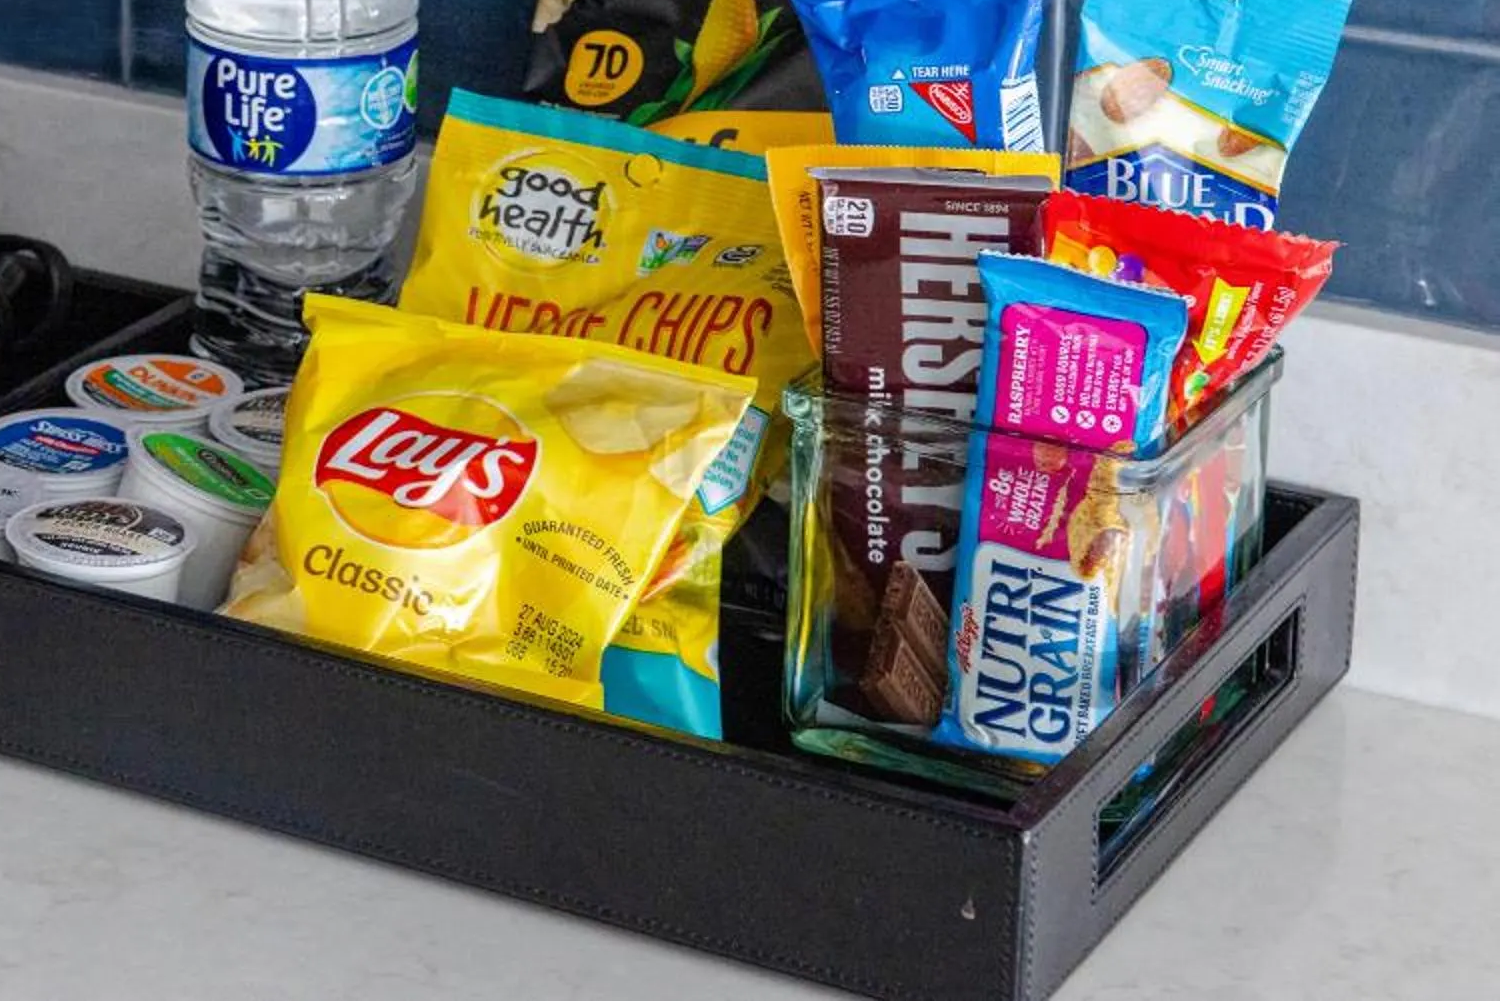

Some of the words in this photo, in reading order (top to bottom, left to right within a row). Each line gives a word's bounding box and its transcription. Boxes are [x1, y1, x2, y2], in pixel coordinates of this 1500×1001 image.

[217, 58, 297, 100] Pure
[584, 42, 629, 80] 70
[912, 66, 939, 78] TEAR
[941, 64, 970, 77] HERE
[1198, 52, 1245, 76] Smart
[224, 92, 285, 138] Life
[496, 166, 607, 212] good
[945, 200, 981, 213] SINCE
[983, 200, 1010, 214] 1894
[1107, 156, 1216, 209] BLUE
[479, 194, 604, 249] health
[846, 199, 869, 234] 210
[617, 291, 774, 377] CHIPS
[1057, 334, 1074, 374] SOURCE
[867, 366, 892, 427] milk
[1007, 323, 1031, 425] RASPBERRY
[1053, 375, 1068, 403] GOOD
[1105, 369, 1121, 412] ENERGY
[1079, 393, 1091, 408] NO
[325, 410, 524, 510] Lay's
[988, 468, 1015, 496] 8g
[865, 433, 891, 564] chocolate
[1007, 470, 1036, 523] WHOLE
[1024, 472, 1051, 531] GRAINS
[521, 539, 549, 565] UNTIL
[550, 552, 595, 585] PRINTED
[595, 577, 623, 599] DATE
[523, 519, 605, 550] GUARANTEED
[602, 545, 635, 586] FRESH
[302, 543, 435, 617] Classic
[1087, 585, 1100, 617] BARS
[518, 603, 536, 621] 27
[533, 610, 560, 637] AUG
[556, 625, 585, 650] 2024
[956, 600, 980, 675] Kellogg's
[974, 559, 1033, 738] NUTRI
[1082, 618, 1097, 683] BREAKFAST
[1027, 567, 1086, 743] GRAIN
[1078, 682, 1092, 723] BAKED
